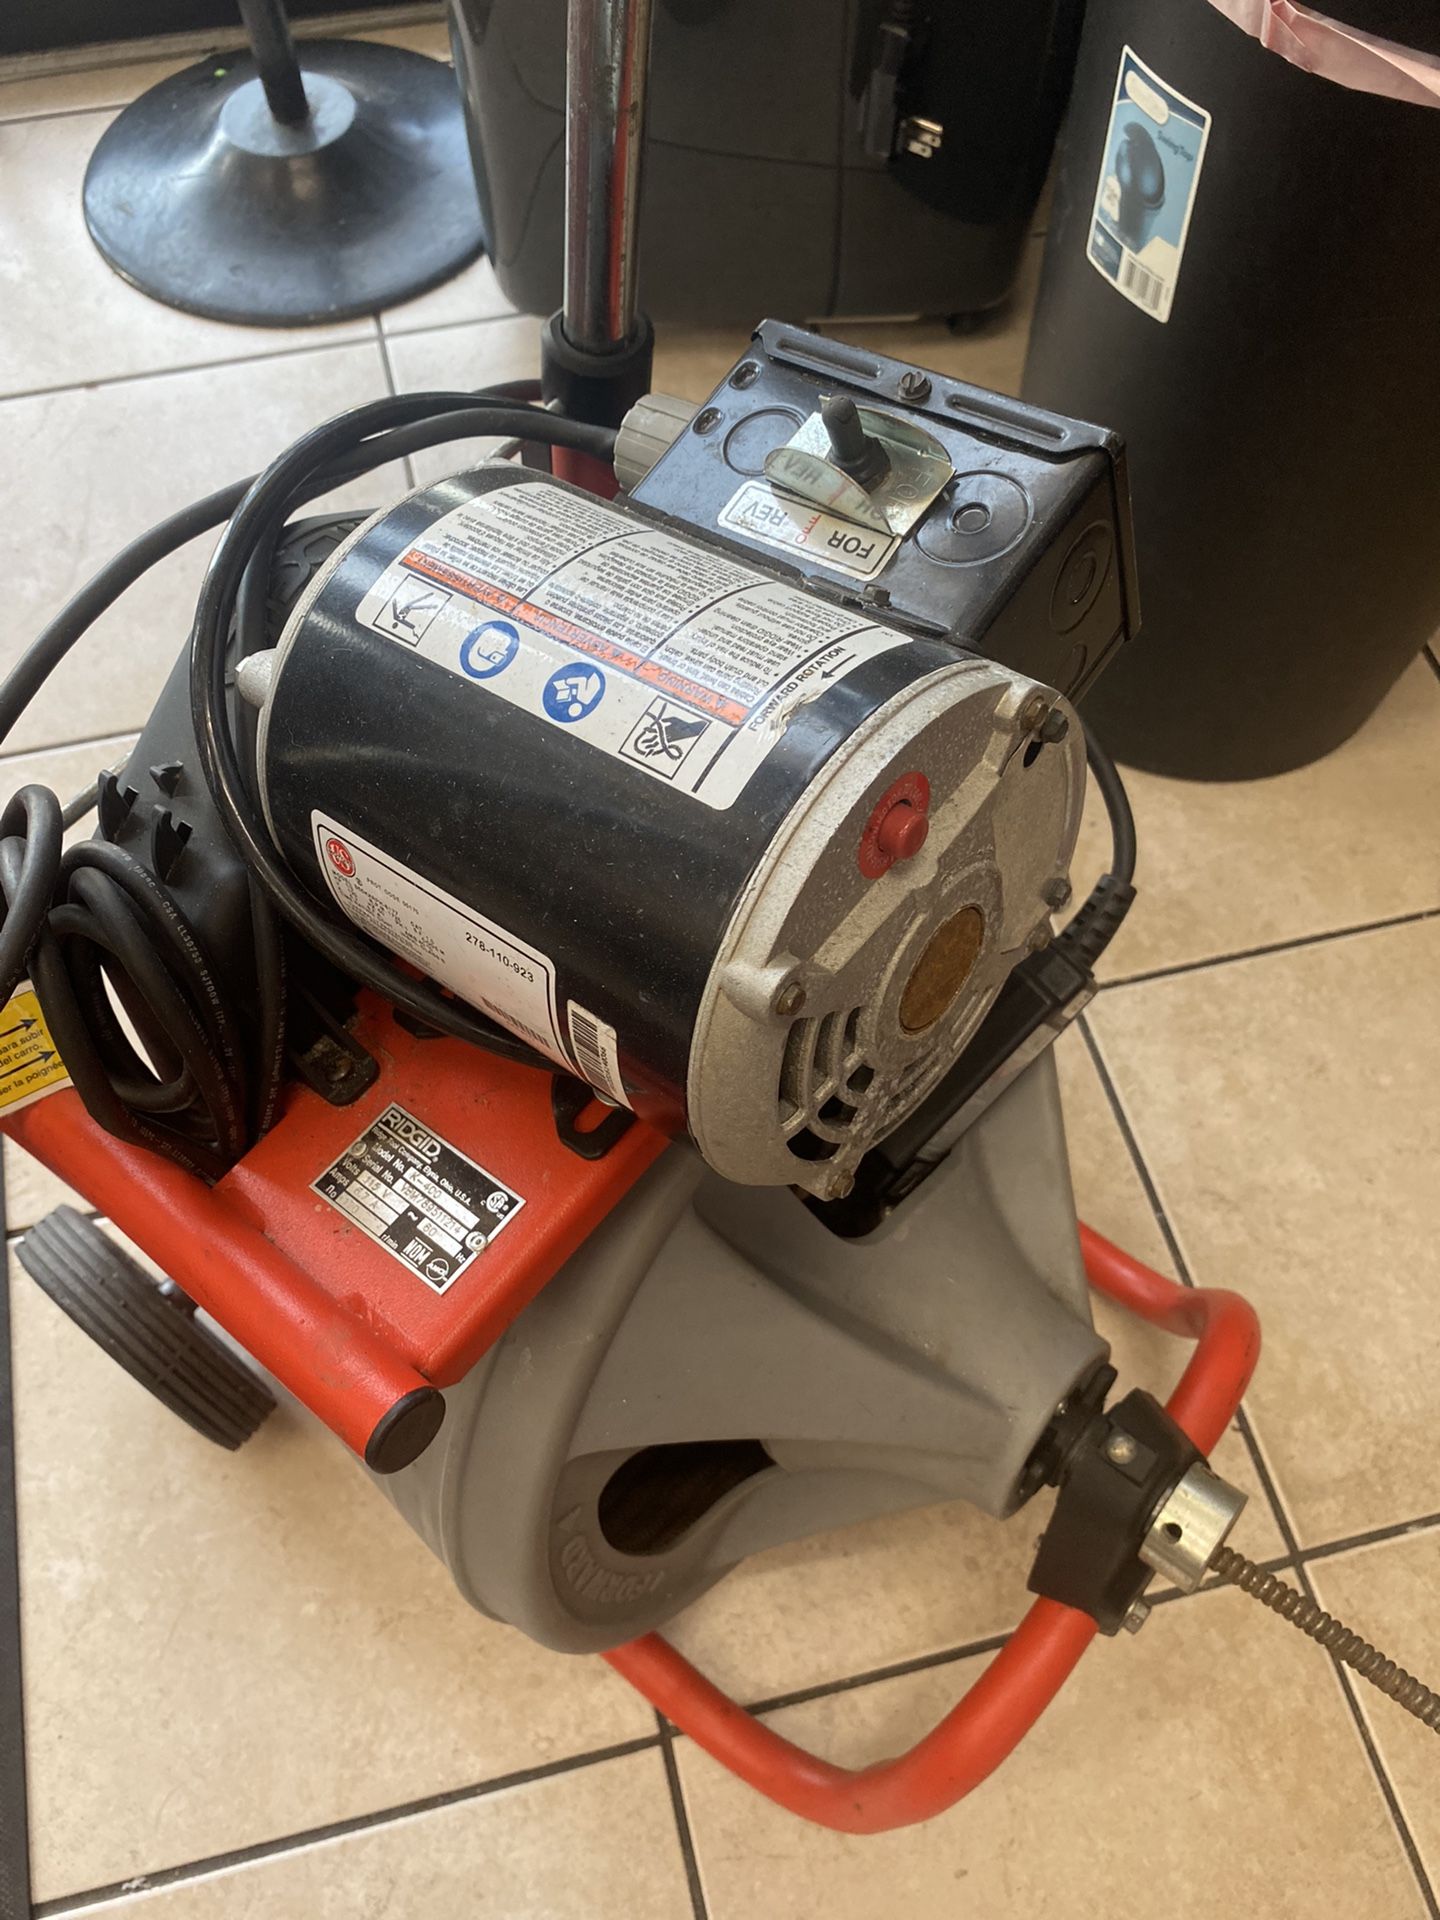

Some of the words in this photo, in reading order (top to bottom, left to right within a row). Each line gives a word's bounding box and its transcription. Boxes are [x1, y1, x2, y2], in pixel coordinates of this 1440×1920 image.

[742, 496, 786, 527] REV
[793, 508, 821, 547] OFF
[826, 527, 875, 561] FOR
[748, 681, 799, 732] FORWARD
[796, 646, 846, 682] ROTATION
[465, 931, 534, 984] 278-110-923
[20, 1029, 44, 1045] subir
[14, 1079, 24, 1087] la
[381, 1108, 444, 1160] RIDGID
[328, 1166, 351, 1187] Amps
[340, 1157, 362, 1176] Volts
[360, 1153, 384, 1173] Serial
[380, 1169, 397, 1184] No.
[391, 1158, 408, 1173] No.
[408, 1171, 443, 1199] K-400
[453, 1188, 473, 1205] U.S.A.
[401, 1237, 432, 1266] NOM
